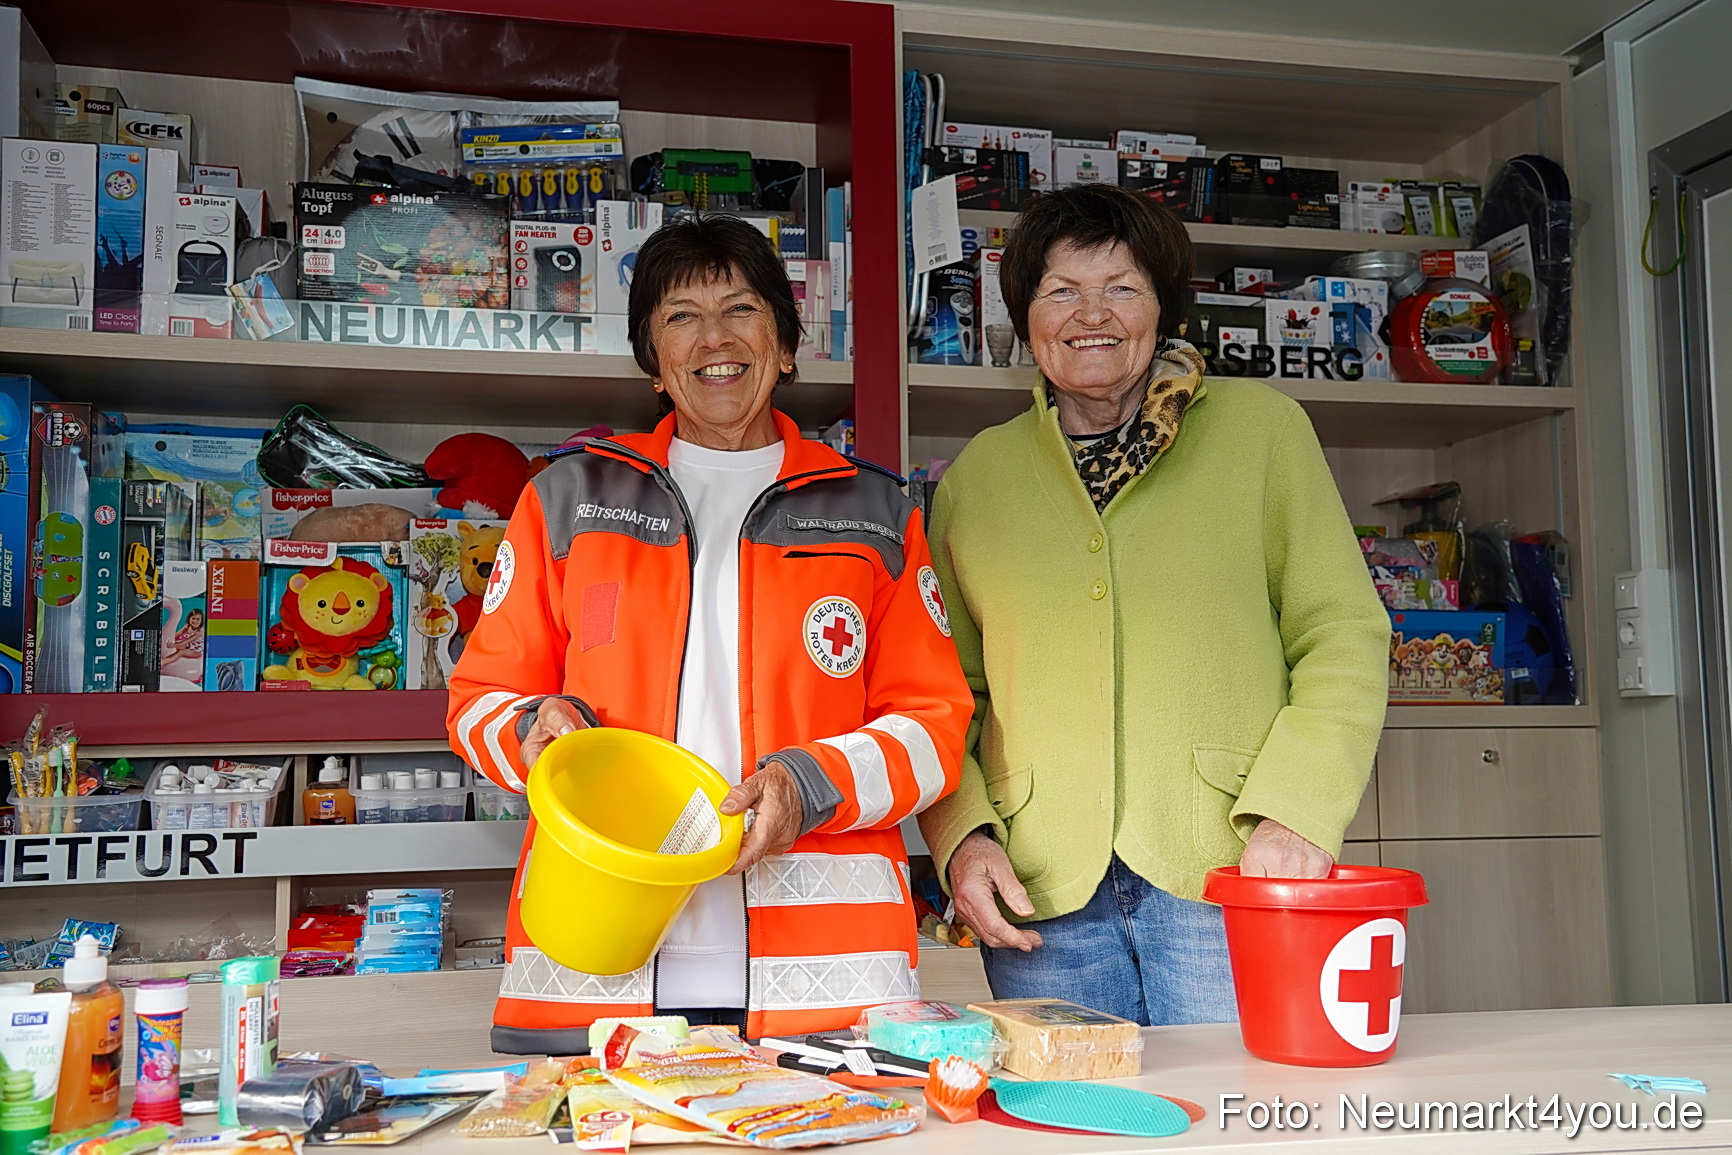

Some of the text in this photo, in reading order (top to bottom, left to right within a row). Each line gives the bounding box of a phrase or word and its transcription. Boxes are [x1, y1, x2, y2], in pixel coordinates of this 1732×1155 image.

[87, 102, 111, 112] 60pcs
[133, 122, 183, 139] GFK
[473, 135, 500, 143] KINZO
[301, 188, 354, 202] Aluguss
[390, 193, 434, 205] alpina
[193, 198, 226, 207] alpina
[301, 201, 334, 215] Topf
[601, 206, 612, 237] alpina
[304, 228, 319, 238] 24
[324, 229, 342, 238] 4.0
[515, 230, 557, 239] FAN HEATER
[154, 225, 164, 260] SEGNALE
[1456, 255, 1486, 264] outdoor
[1464, 262, 1485, 271] lights
[114, 313, 138, 321] Clock
[300, 302, 593, 352] NEUMARKT
[1187, 341, 1364, 381] RSBERG
[52, 412, 63, 446] SOCCER
[275, 492, 330, 505] fisher-price
[576, 503, 670, 533] REITSCHAFTEN
[796, 519, 860, 530] WALTRAUD
[274, 543, 324, 554] Fisher-Price
[171, 566, 199, 574] Bestway
[2, 549, 14, 608] DISCGOLFSET
[211, 566, 225, 613] INTEX
[94, 551, 111, 682] SCRABBLE
[812, 602, 862, 636] DEUTSCHES
[26, 634, 34, 647] AIR
[810, 631, 861, 671] ROTES KREUZ
[25, 649, 34, 682] SOCCER
[13, 1013, 44, 1025] Elina
[27, 1045, 58, 1055] ALOE
